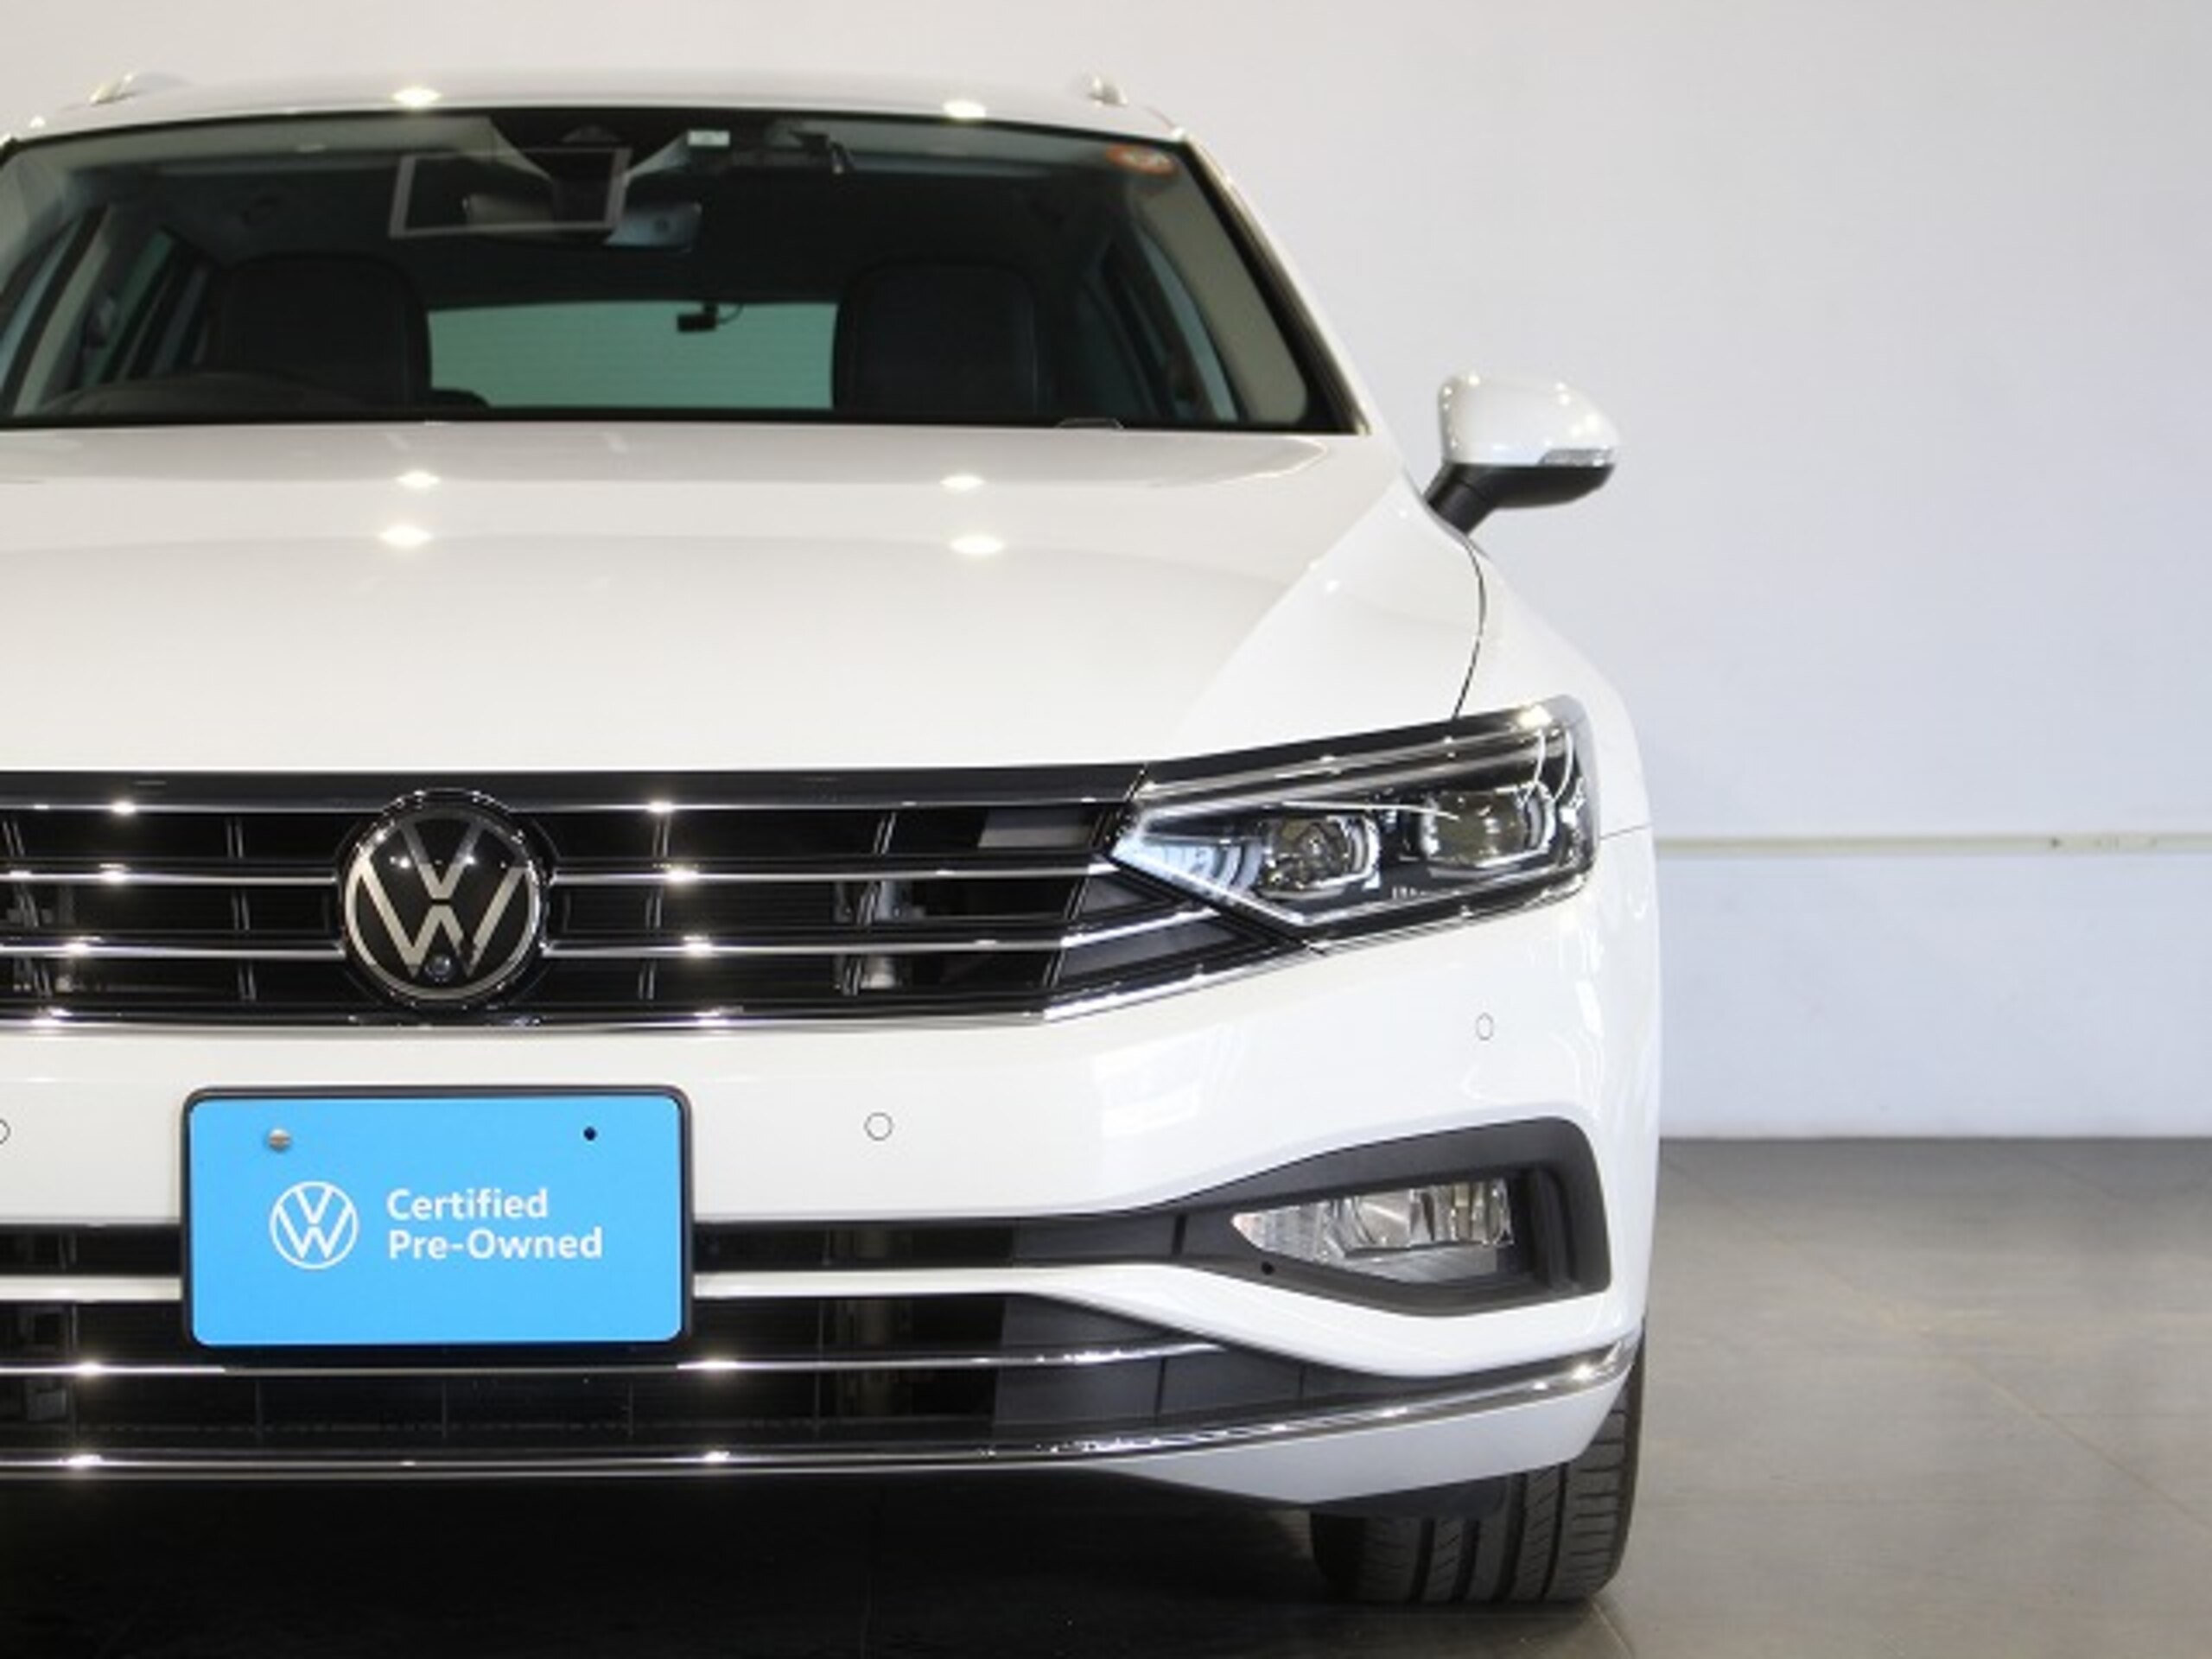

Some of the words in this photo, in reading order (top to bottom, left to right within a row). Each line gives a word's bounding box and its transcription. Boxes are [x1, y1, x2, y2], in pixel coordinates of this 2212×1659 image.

[353, 816, 531, 982] VW
[271, 1183, 358, 1268] VW
[385, 1188, 548, 1220] Certified
[388, 1226, 603, 1259] Pre-Owned
